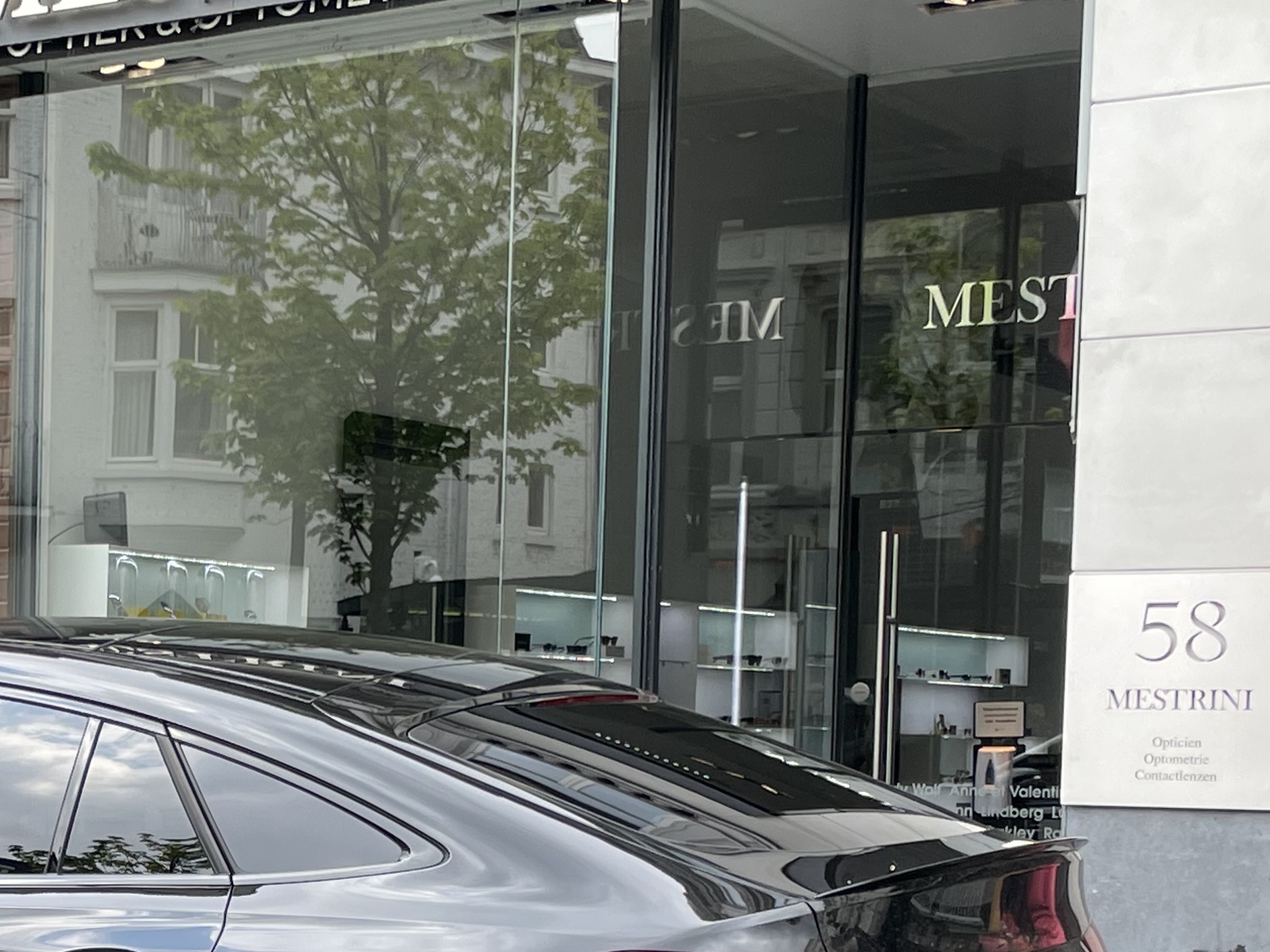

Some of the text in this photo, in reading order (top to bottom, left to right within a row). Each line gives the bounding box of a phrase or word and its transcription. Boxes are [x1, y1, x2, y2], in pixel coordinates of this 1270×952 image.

[1135, 600, 1228, 663] 58
[1106, 688, 1255, 712] MESTRINI
[1152, 736, 1202, 751] Opticien
[1143, 753, 1210, 767] Optometrie
[1134, 769, 1218, 783] Contactlenzen
